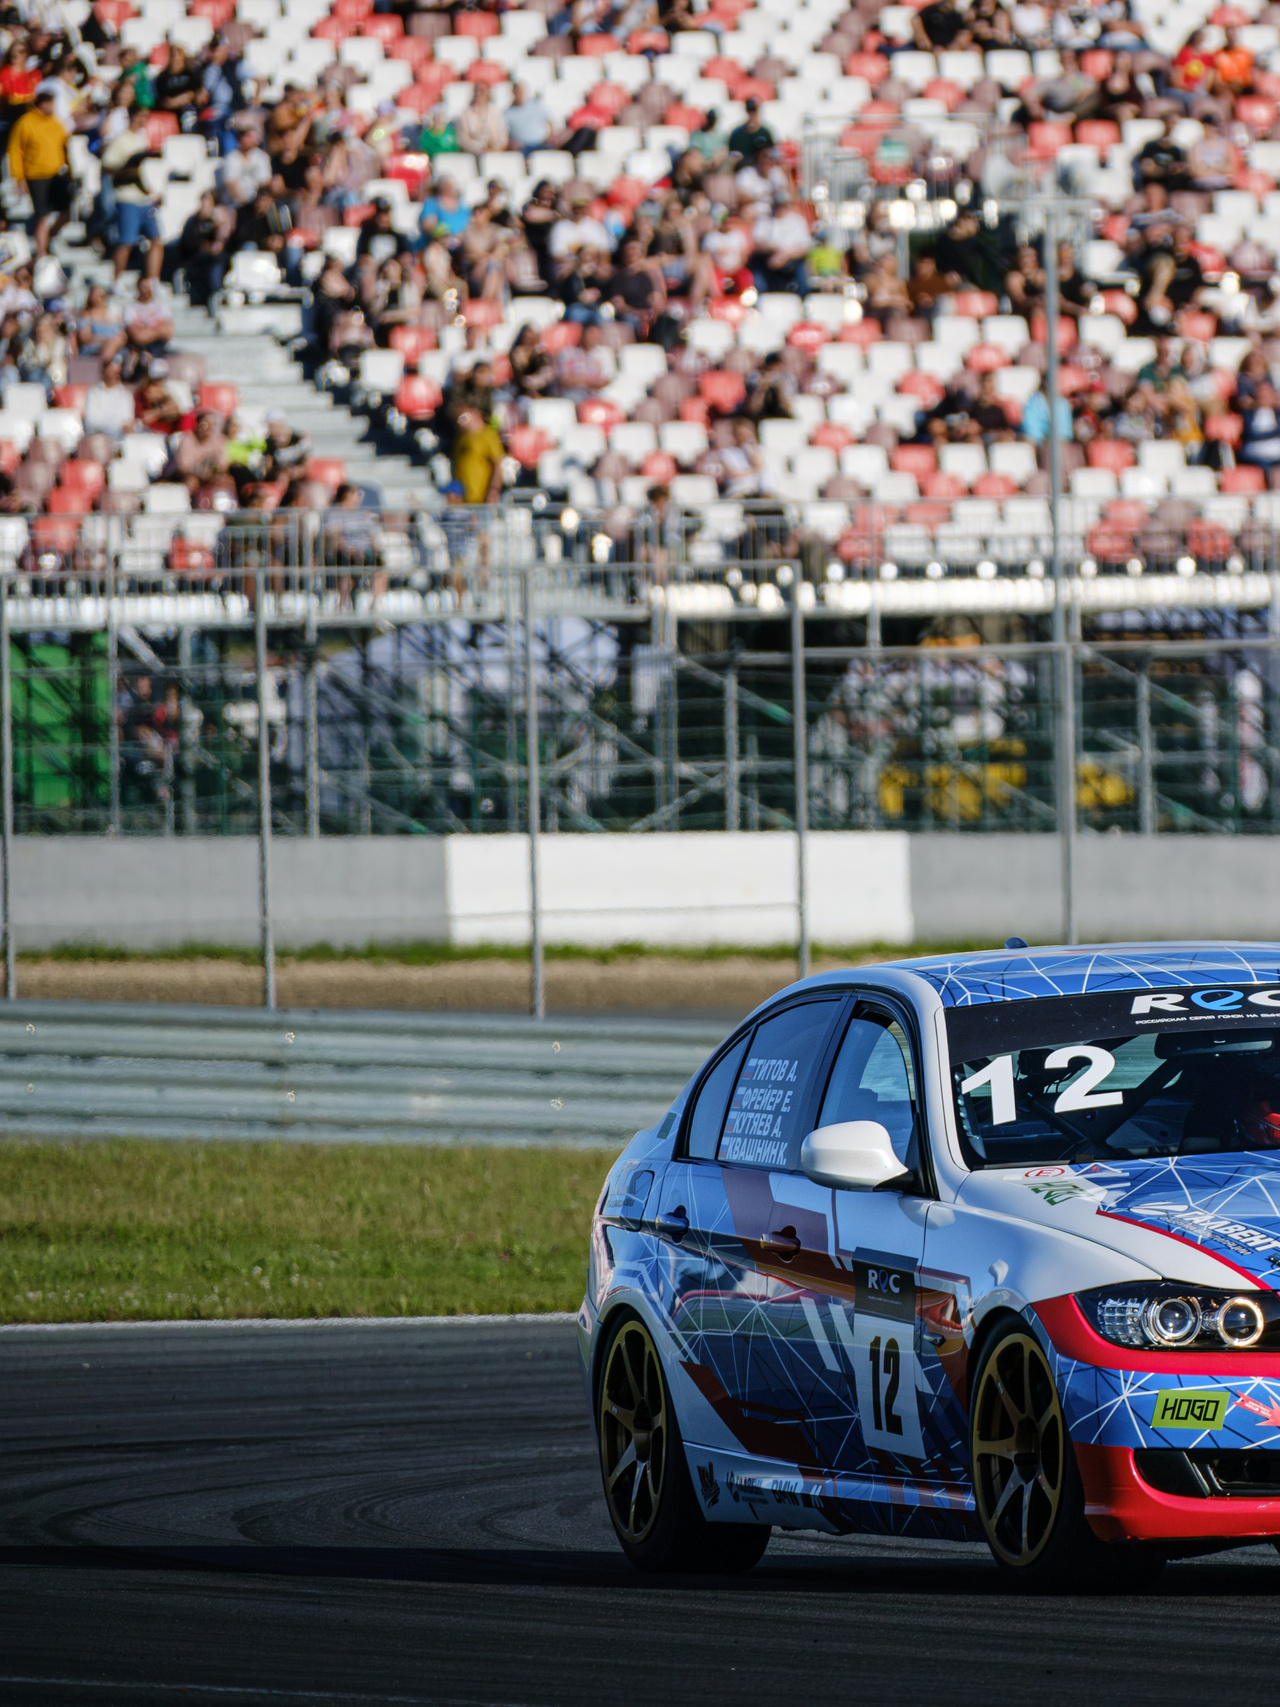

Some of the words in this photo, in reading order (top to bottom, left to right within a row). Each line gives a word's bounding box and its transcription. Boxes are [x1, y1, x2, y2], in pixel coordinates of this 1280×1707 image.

[1135, 1016, 1188, 1025] РОССИЙСКАЯ
[752, 1059, 790, 1081] ТИТОВ
[785, 1060, 799, 1082] А.
[741, 1084, 784, 1111] ФРЕЙЕР
[781, 1090, 794, 1113] Е.
[961, 1045, 1124, 1126] 12
[732, 1111, 774, 1136] КУТЯЕВ
[771, 1115, 783, 1138] А.
[869, 1335, 903, 1437] 12
[1160, 1398, 1220, 1422] HOGO
